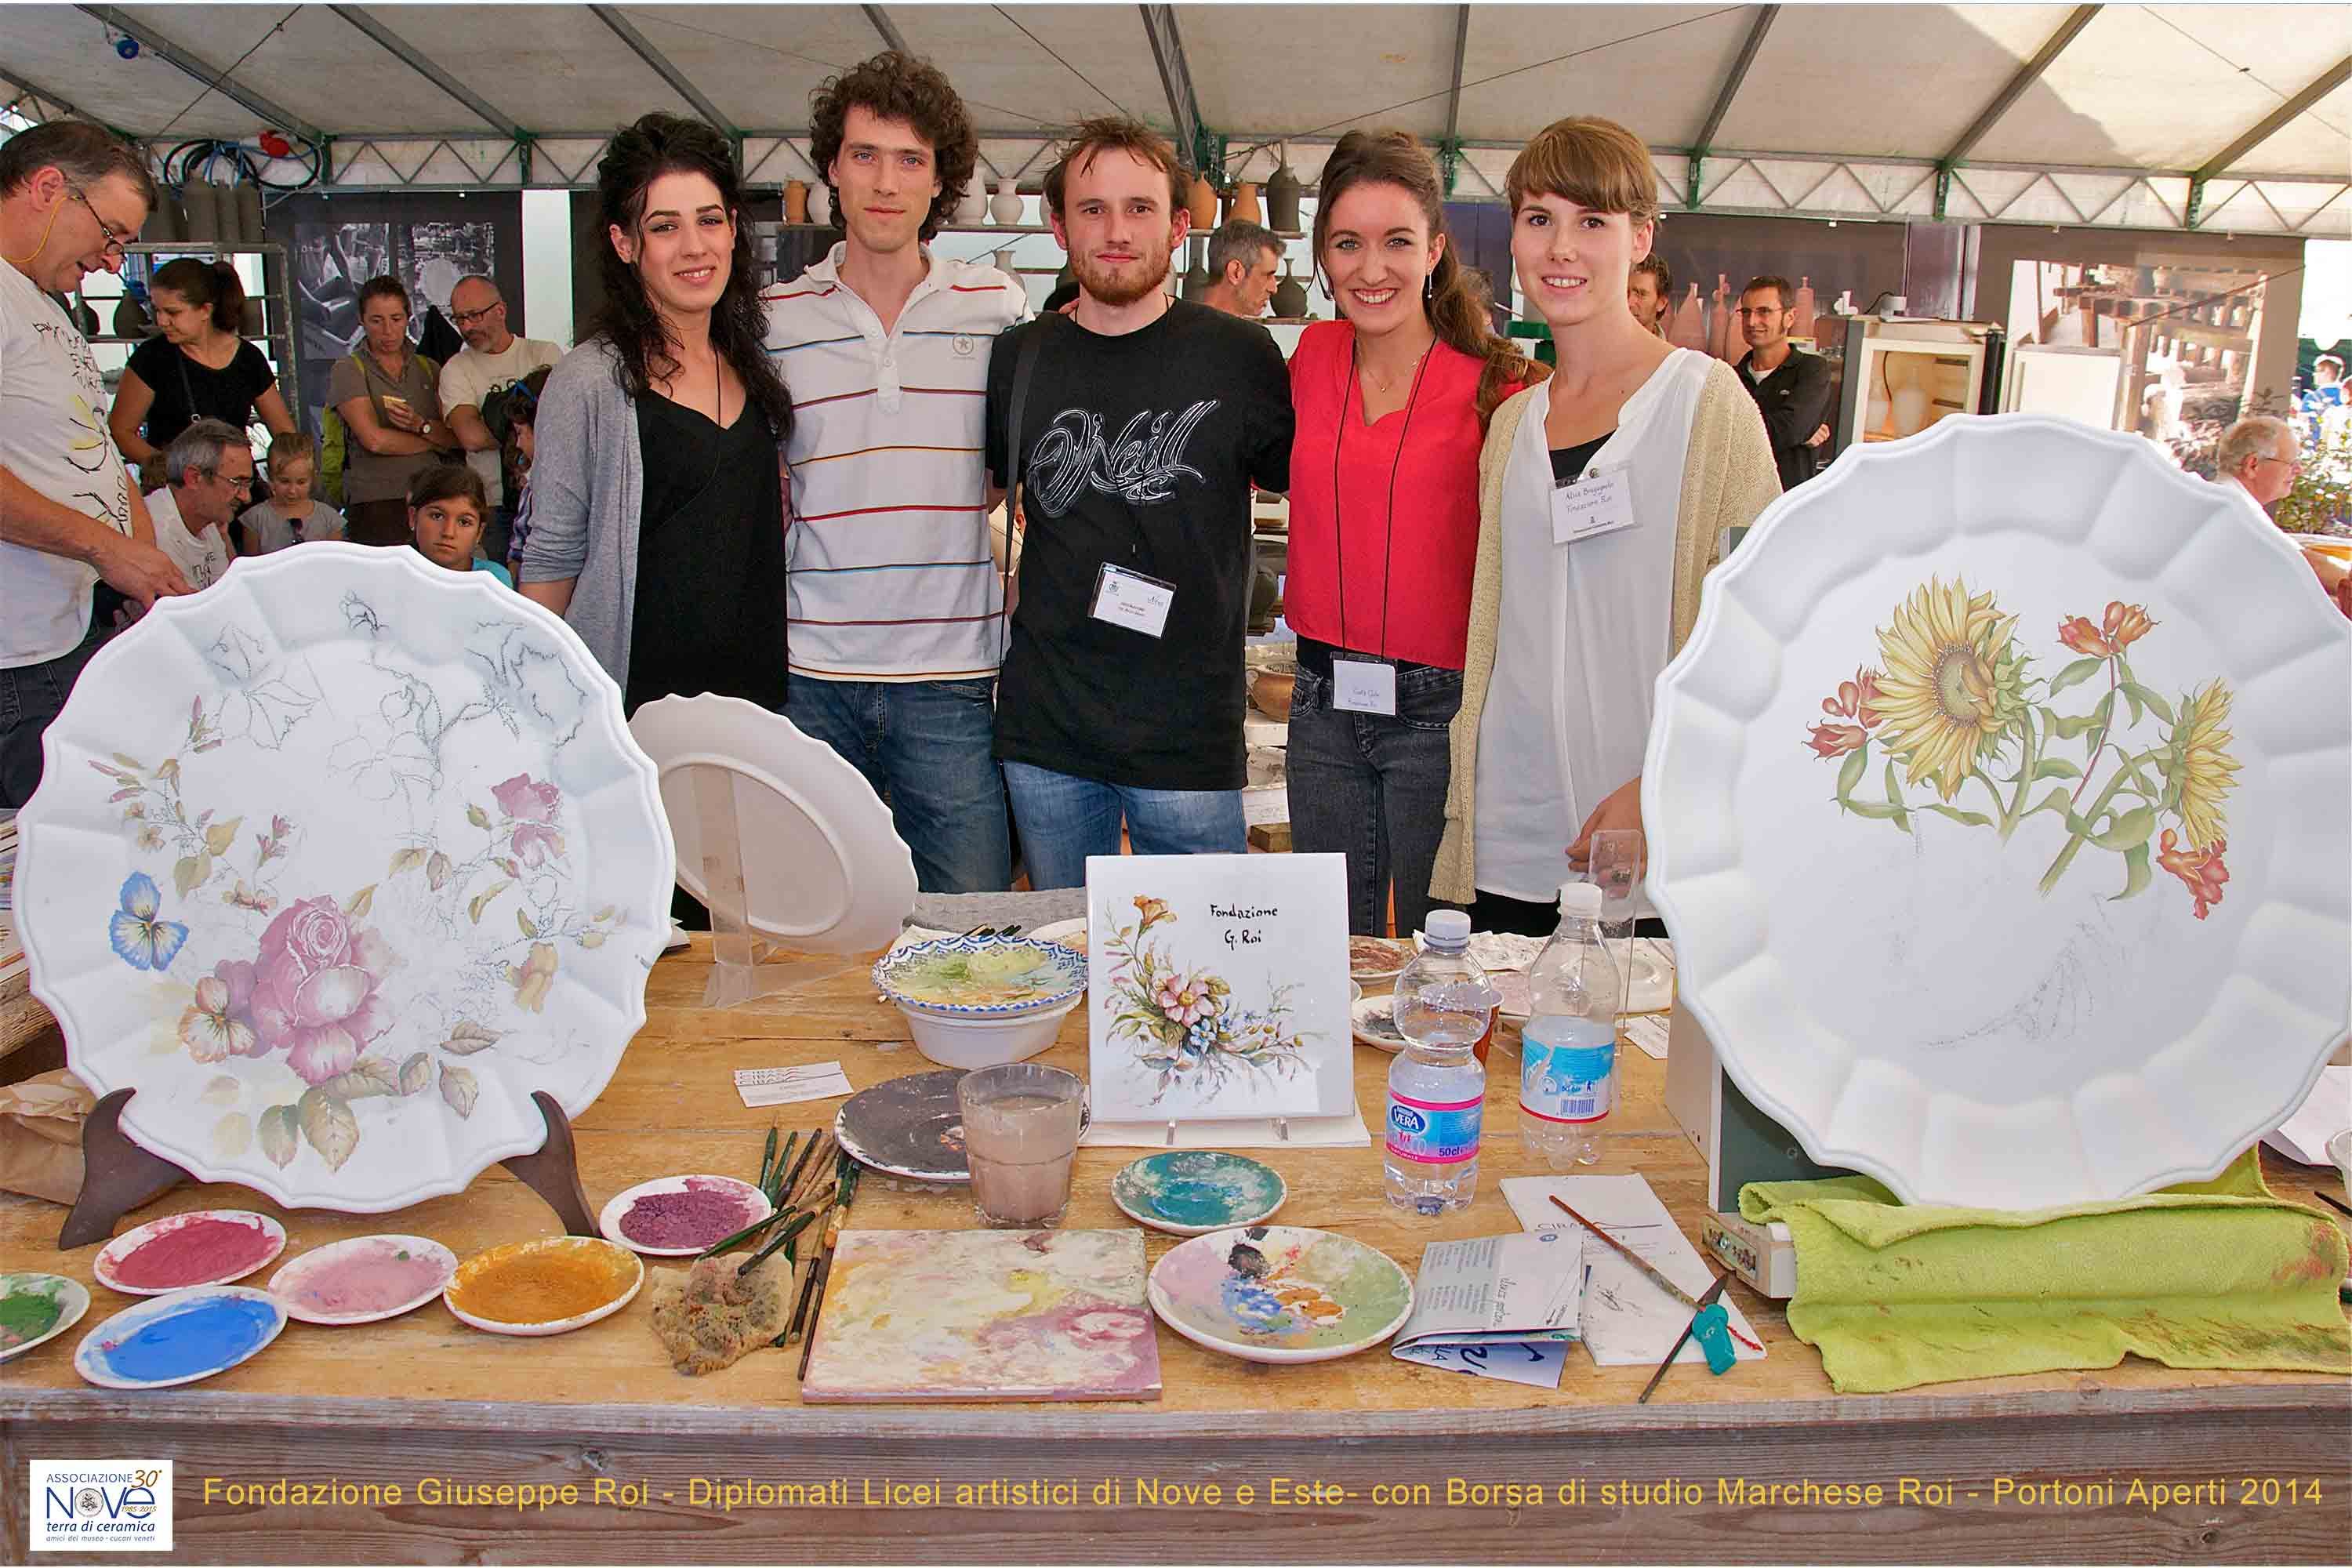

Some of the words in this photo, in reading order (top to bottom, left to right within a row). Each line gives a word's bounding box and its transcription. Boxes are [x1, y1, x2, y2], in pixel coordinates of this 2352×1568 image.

[1027, 400, 1218, 514] O'Neill
[1210, 903, 1278, 919] Fondazione
[1225, 929, 1238, 951] G.
[1242, 929, 1261, 944] Roi
[1395, 1109, 1419, 1130] VERA
